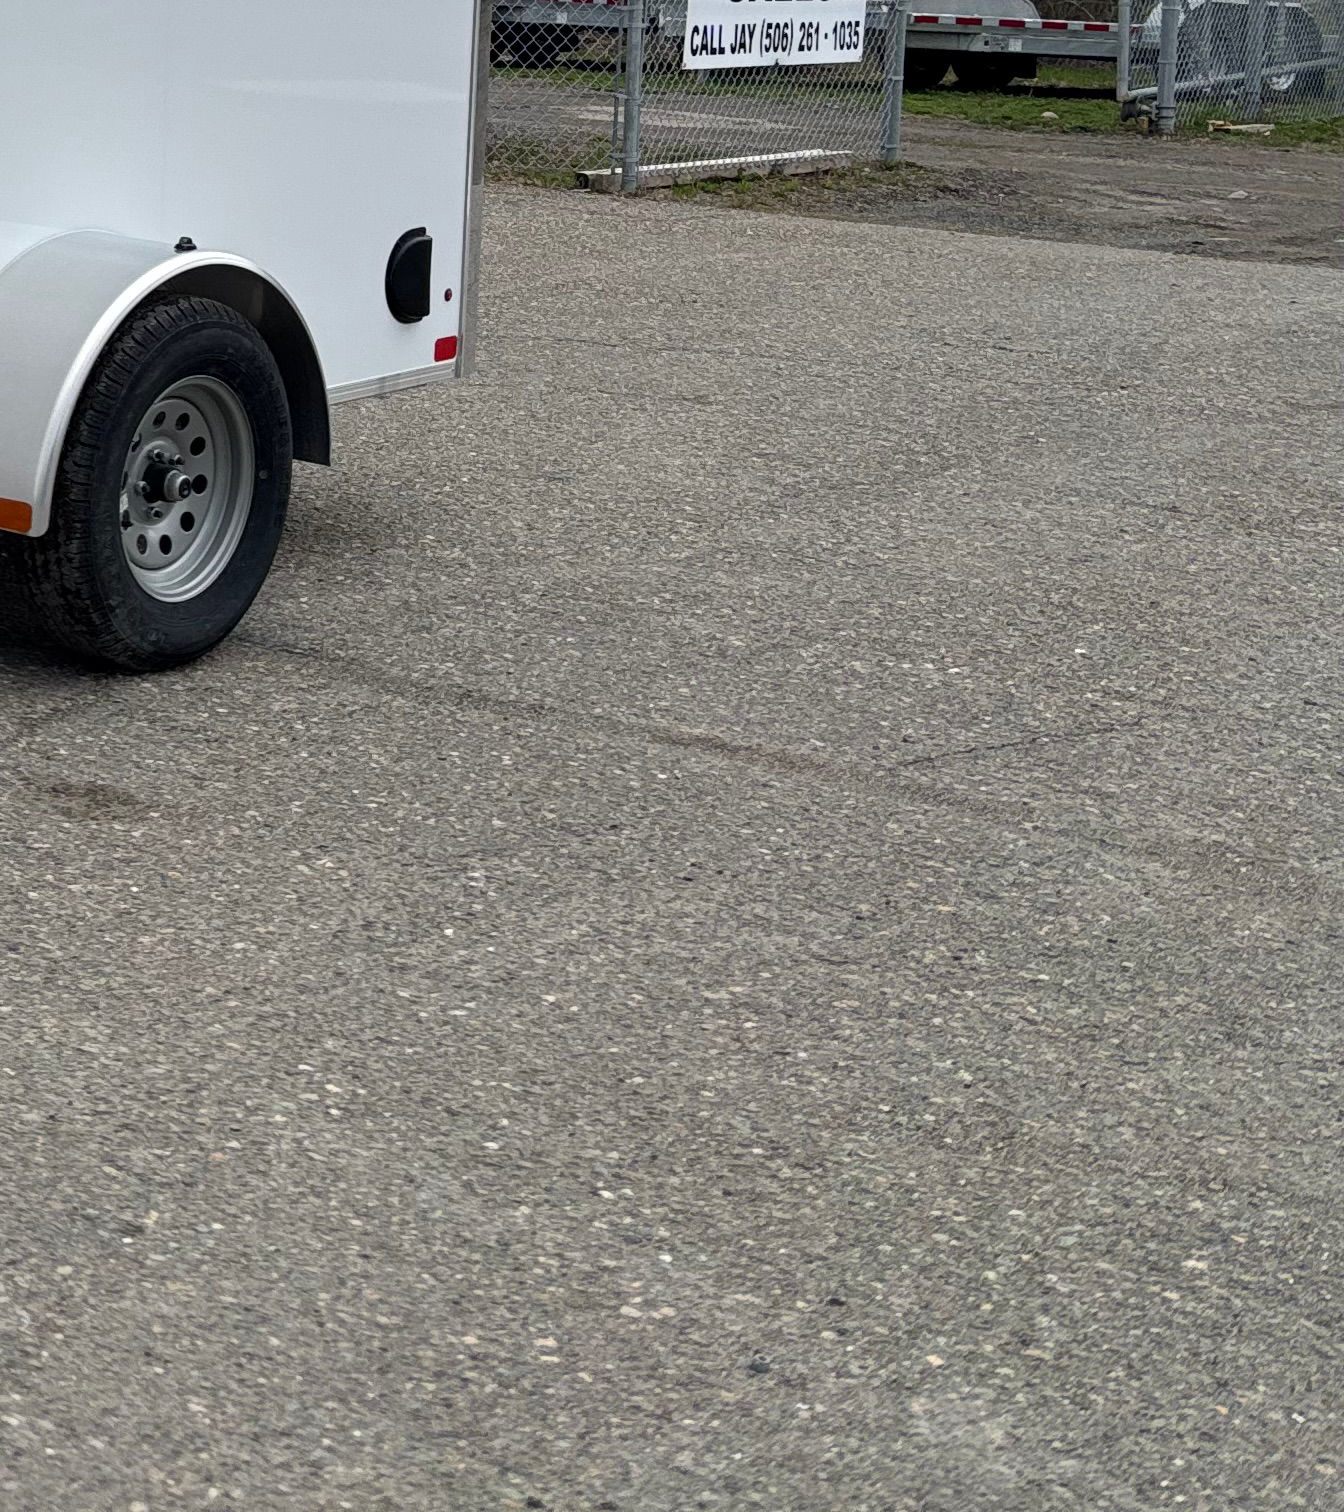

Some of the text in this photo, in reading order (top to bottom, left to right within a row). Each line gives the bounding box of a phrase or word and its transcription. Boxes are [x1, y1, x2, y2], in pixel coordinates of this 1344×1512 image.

[690, 24, 725, 56] CALL
[730, 23, 756, 54] JAY
[760, 18, 793, 57] (506)
[798, 21, 820, 52] 261
[832, 20, 861, 51] 1035
